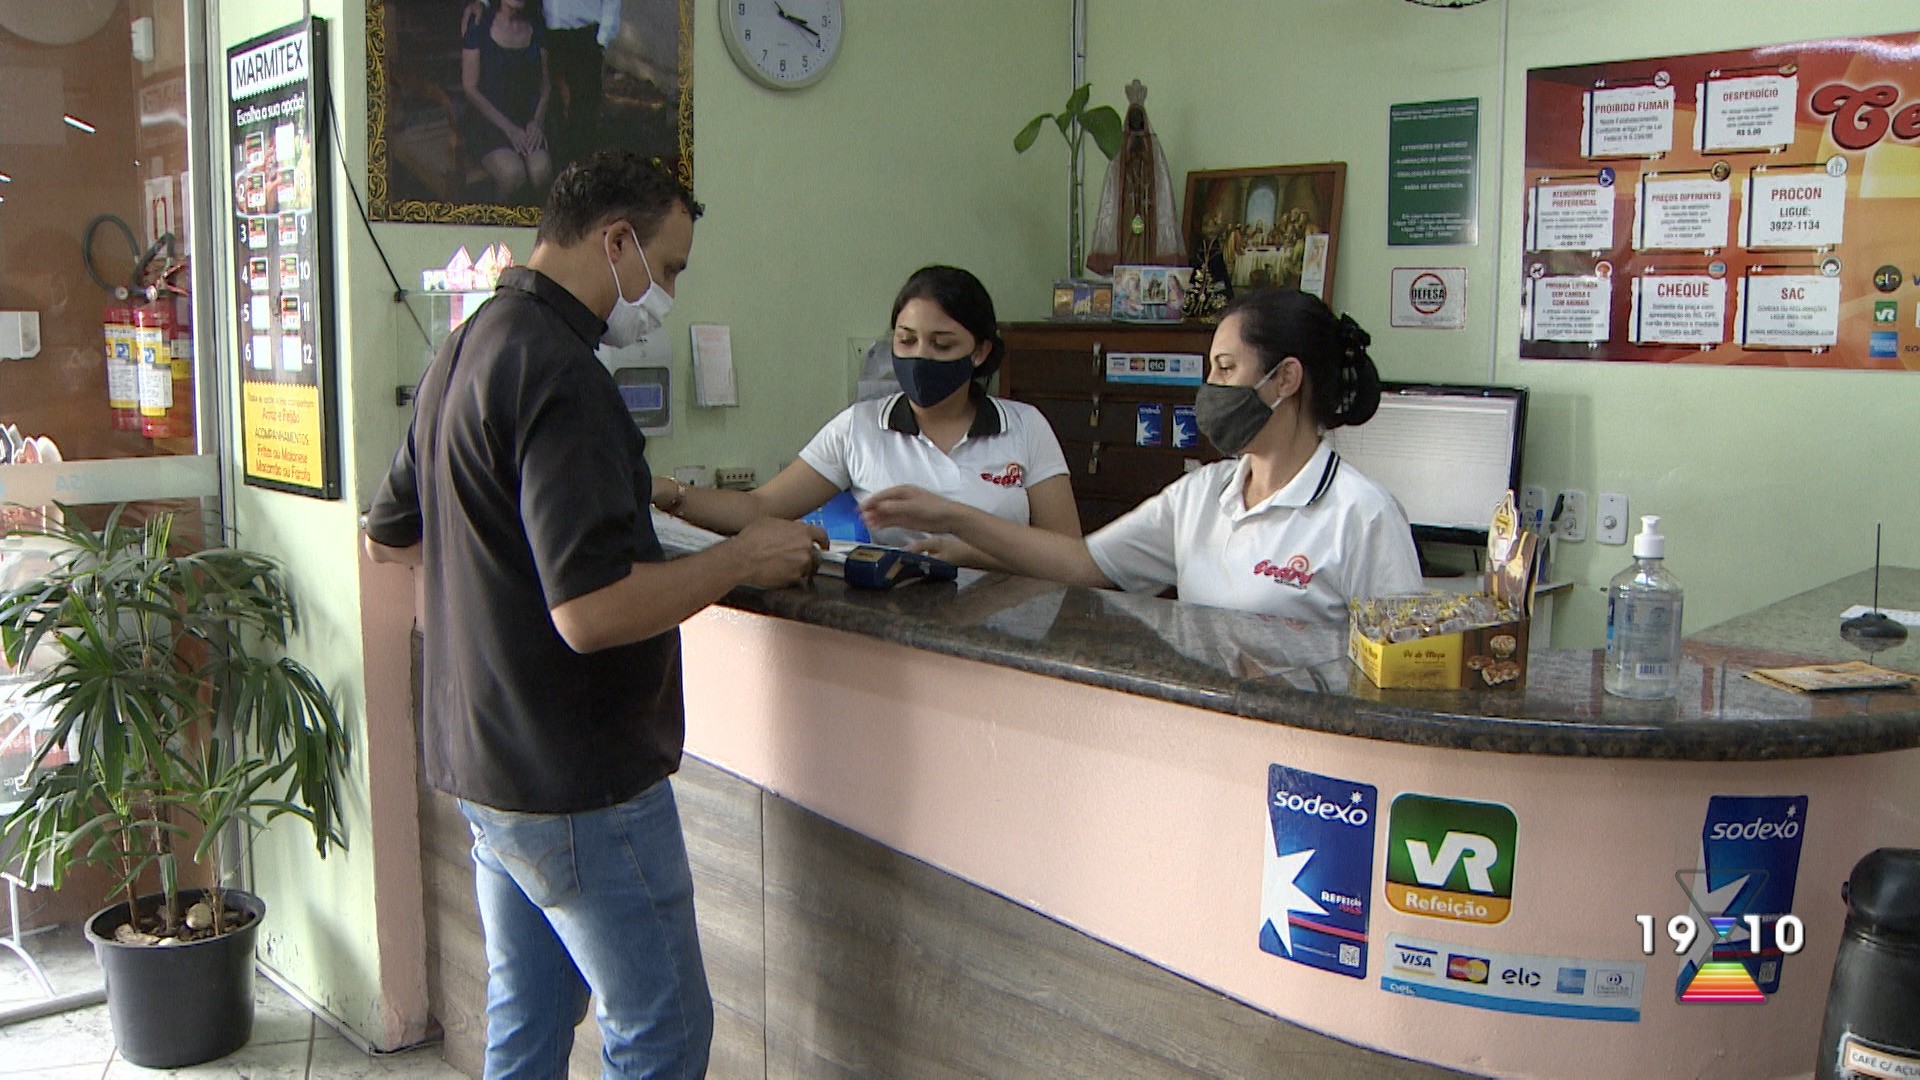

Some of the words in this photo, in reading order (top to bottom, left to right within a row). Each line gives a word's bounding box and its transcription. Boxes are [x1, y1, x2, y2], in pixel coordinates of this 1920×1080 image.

[235, 39, 304, 90] MARMITEX
[1723, 88, 1779, 101] DESPERDÍCIO
[1595, 103, 1636, 114] PROIBIDO
[1637, 100, 1670, 112] FUMAR
[1552, 199, 1597, 208] PREFERENCIAL
[1651, 194, 1679, 203] PREÇOS
[1771, 187, 1822, 201] PROCON
[239, 223, 247, 244] 3
[300, 215, 307, 236] 9
[1769, 221, 1820, 232] 3922-1134
[241, 266, 248, 284] 4
[300, 261, 311, 280] 10
[1411, 287, 1445, 300] DEFESA
[1657, 282, 1710, 297] CHEQUE
[1781, 287, 1805, 300] SAC
[242, 303, 250, 322] 5
[302, 301, 311, 322] 11
[244, 343, 251, 362] 6
[302, 343, 313, 364] 12
[1273, 790, 1369, 826] sodexo
[1710, 817, 1798, 841] sodexo
[1404, 831, 1498, 892] VR
[1405, 890, 1489, 919] Refeição
[1400, 952, 1432, 968] VISA
[1501, 967, 1542, 987] elo
